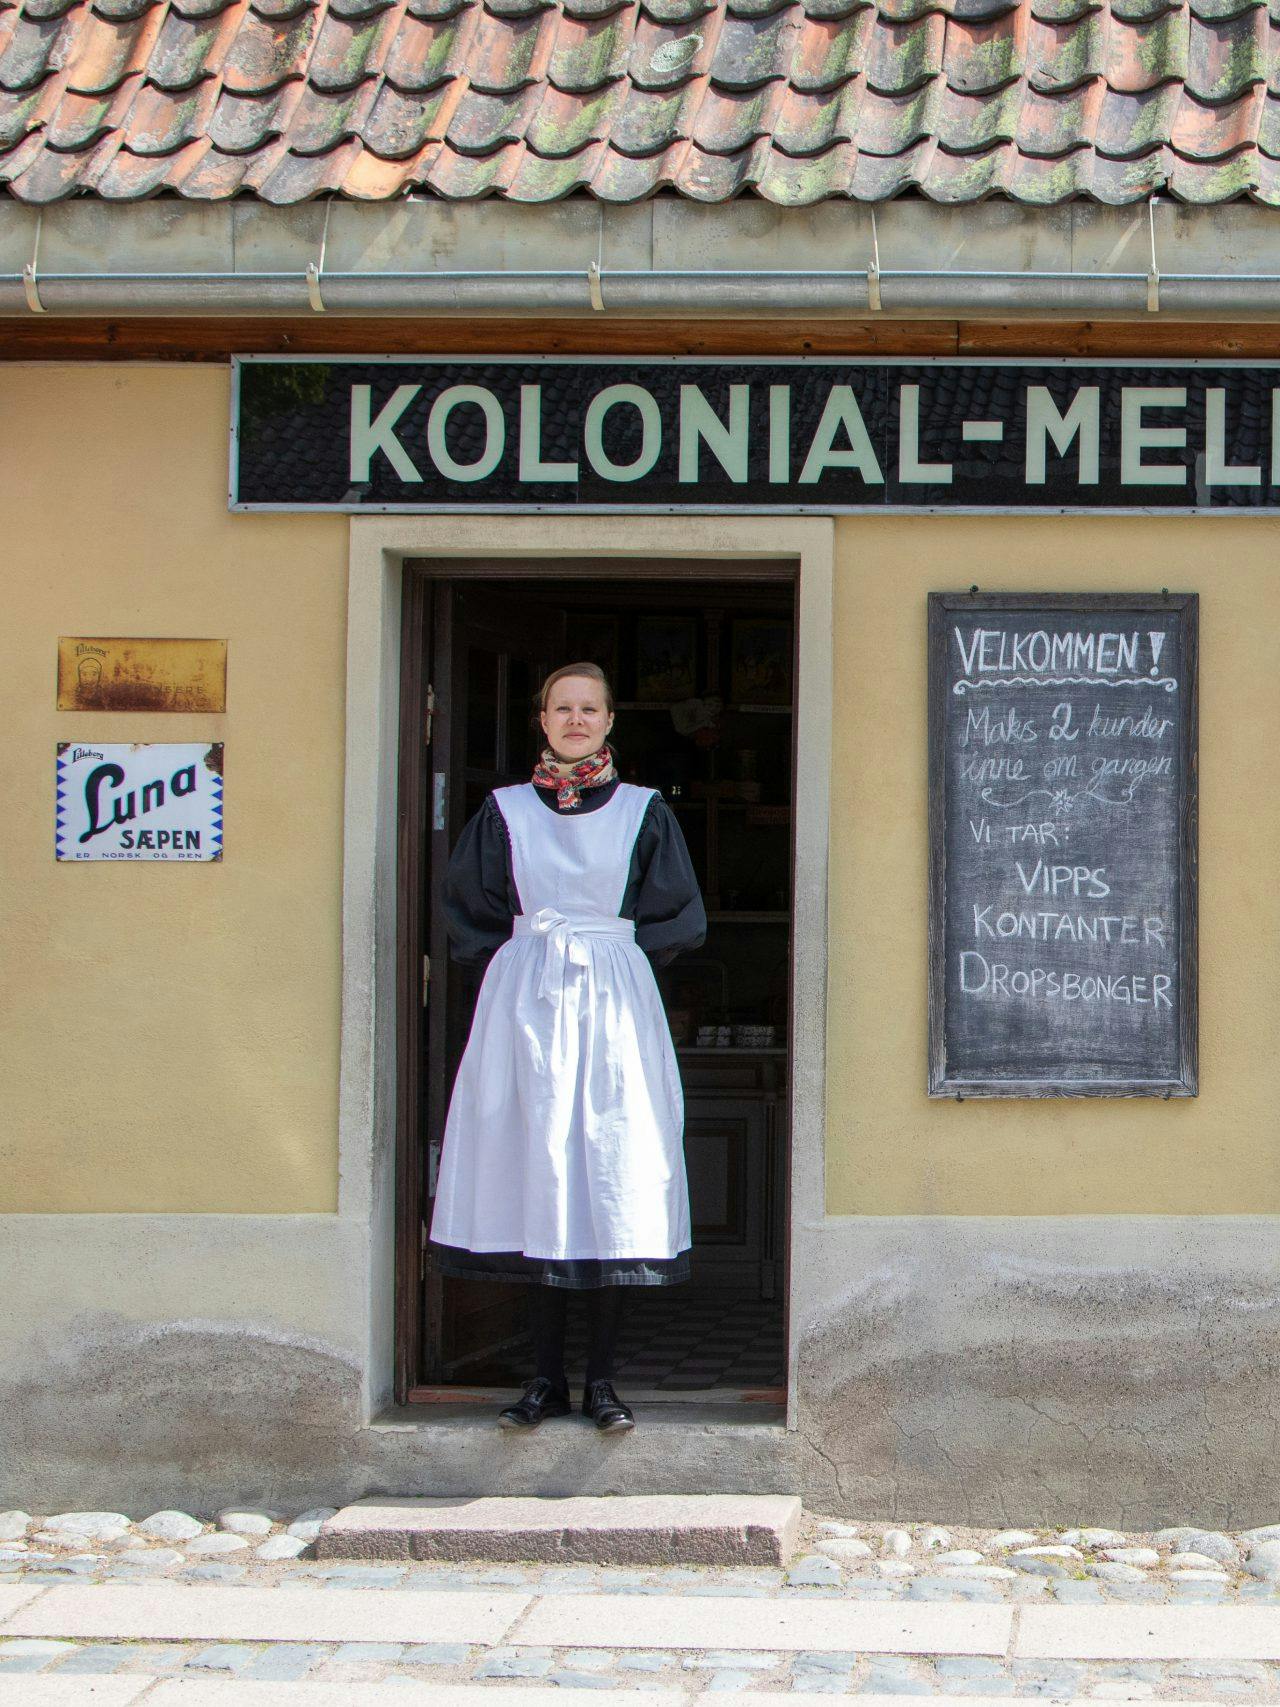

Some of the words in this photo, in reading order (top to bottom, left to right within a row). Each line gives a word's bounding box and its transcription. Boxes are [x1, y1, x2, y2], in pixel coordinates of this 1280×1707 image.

[961, 705, 1038, 747] Maks
[1048, 703, 1079, 741] 2
[1087, 703, 1174, 740] kunder
[72, 747, 104, 763] Lilleborg
[962, 753, 1032, 781] inne
[1044, 755, 1078, 778] om
[1086, 755, 1171, 796] gangen
[79, 763, 197, 843] Luna
[120, 829, 201, 850] SÆPEN
[1015, 859, 1111, 899] VIPPS
[973, 904, 1167, 948] KONTANTER
[959, 951, 1173, 1010] DROPSBONGER
